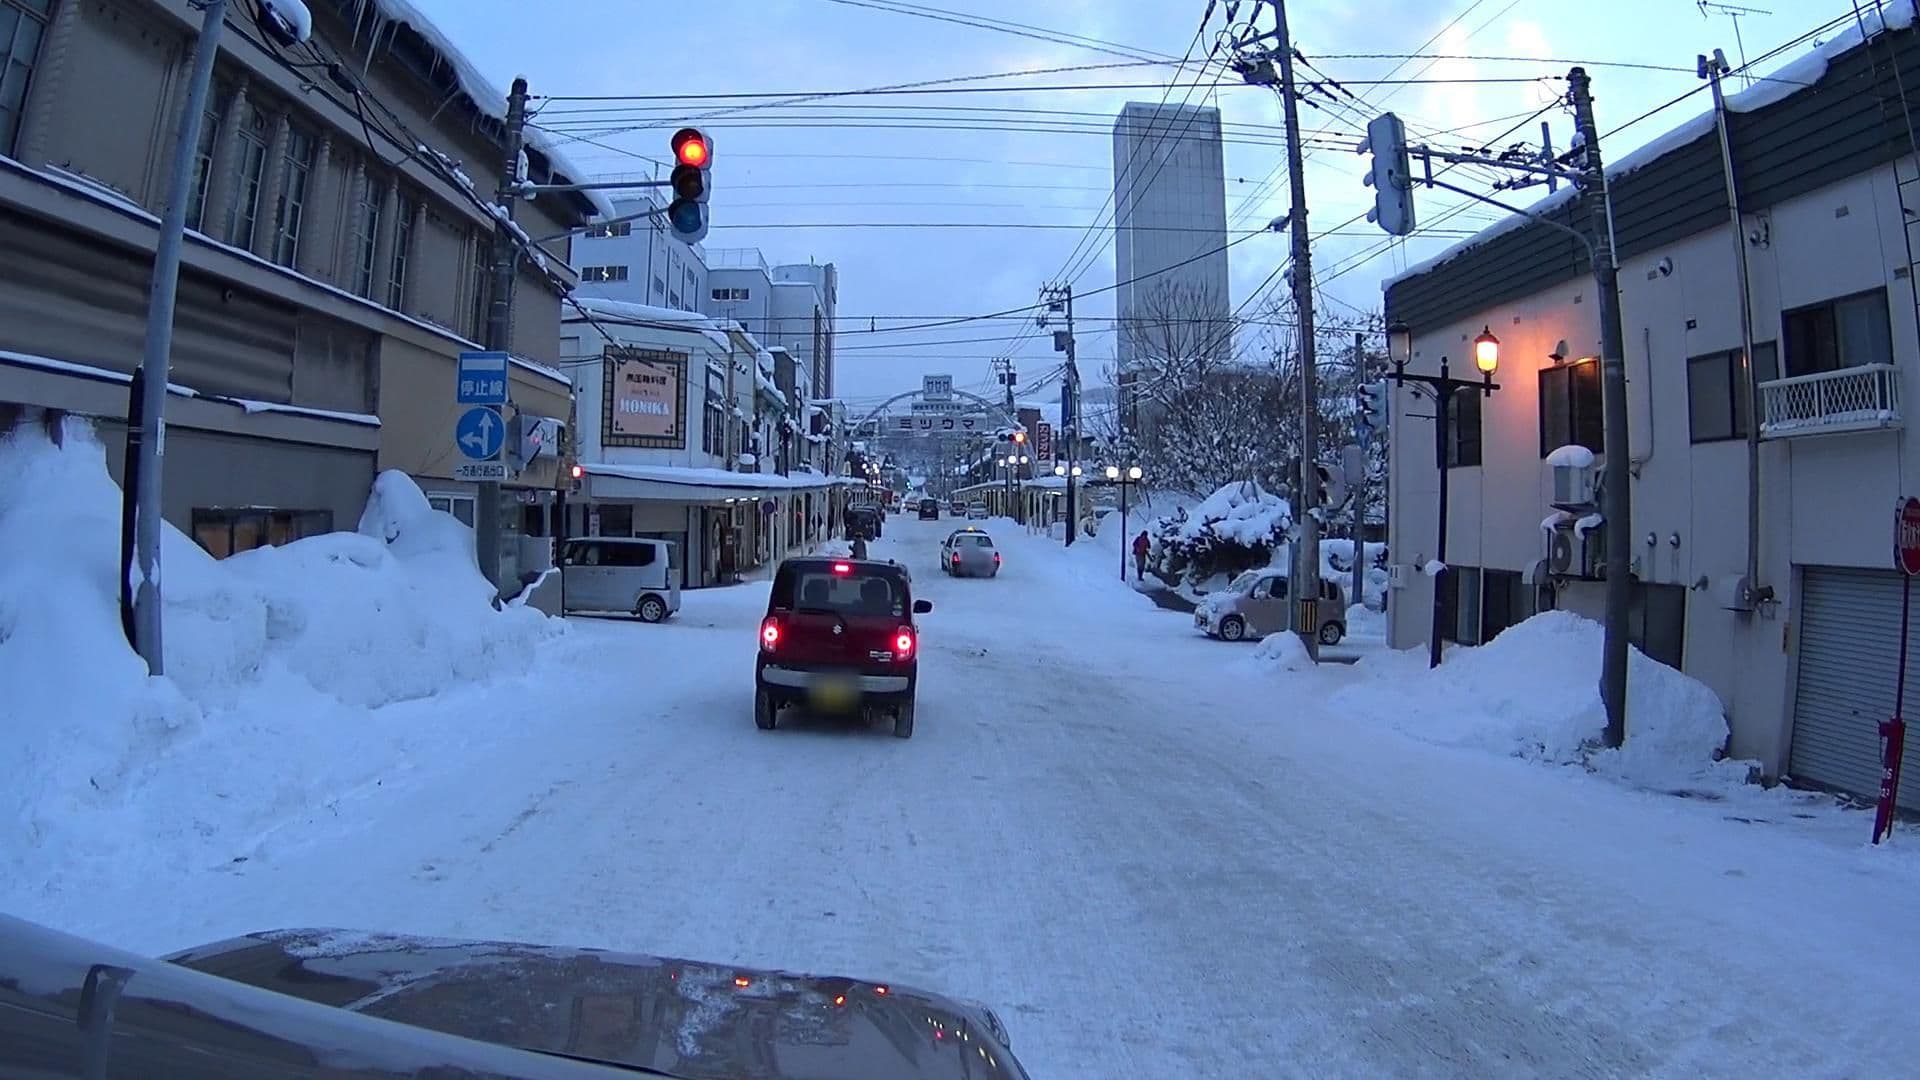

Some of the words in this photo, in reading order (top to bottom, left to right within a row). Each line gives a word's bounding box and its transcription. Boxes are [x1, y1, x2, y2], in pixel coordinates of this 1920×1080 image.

[461, 380, 503, 396] 停止線
[619, 398, 670, 416] MONIKA
[899, 418, 975, 430] ミツウマ
